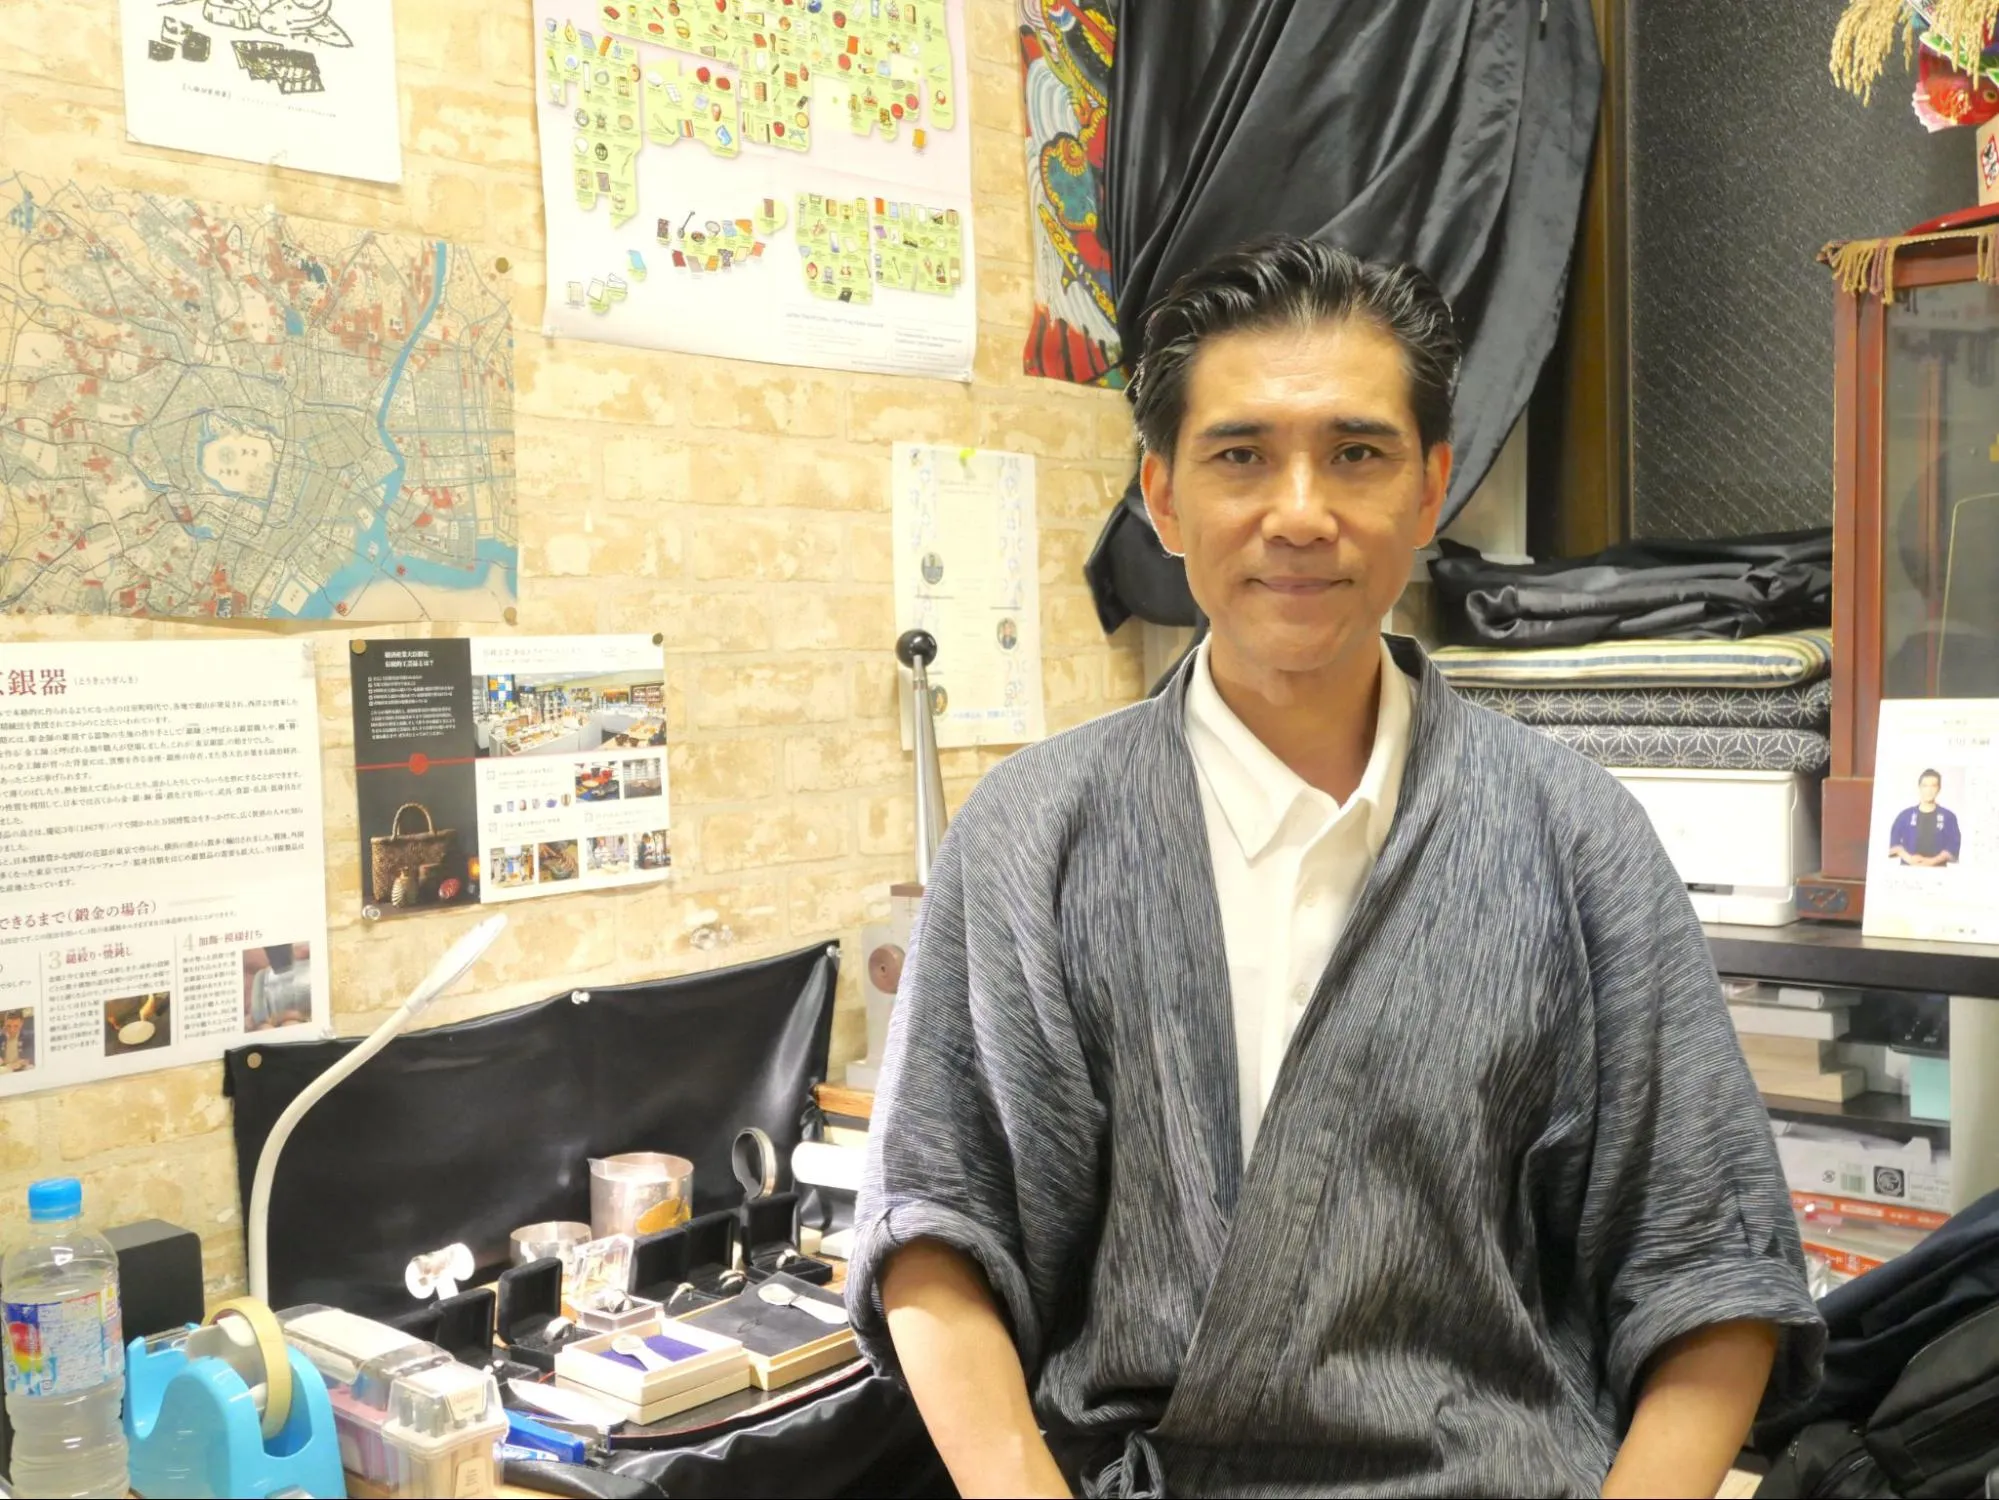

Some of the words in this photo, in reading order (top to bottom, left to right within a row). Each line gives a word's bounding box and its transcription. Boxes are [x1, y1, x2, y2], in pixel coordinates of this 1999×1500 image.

[0, 668, 67, 696] 銀器
[182, 932, 194, 951] 4
[48, 950, 61, 970] 3
